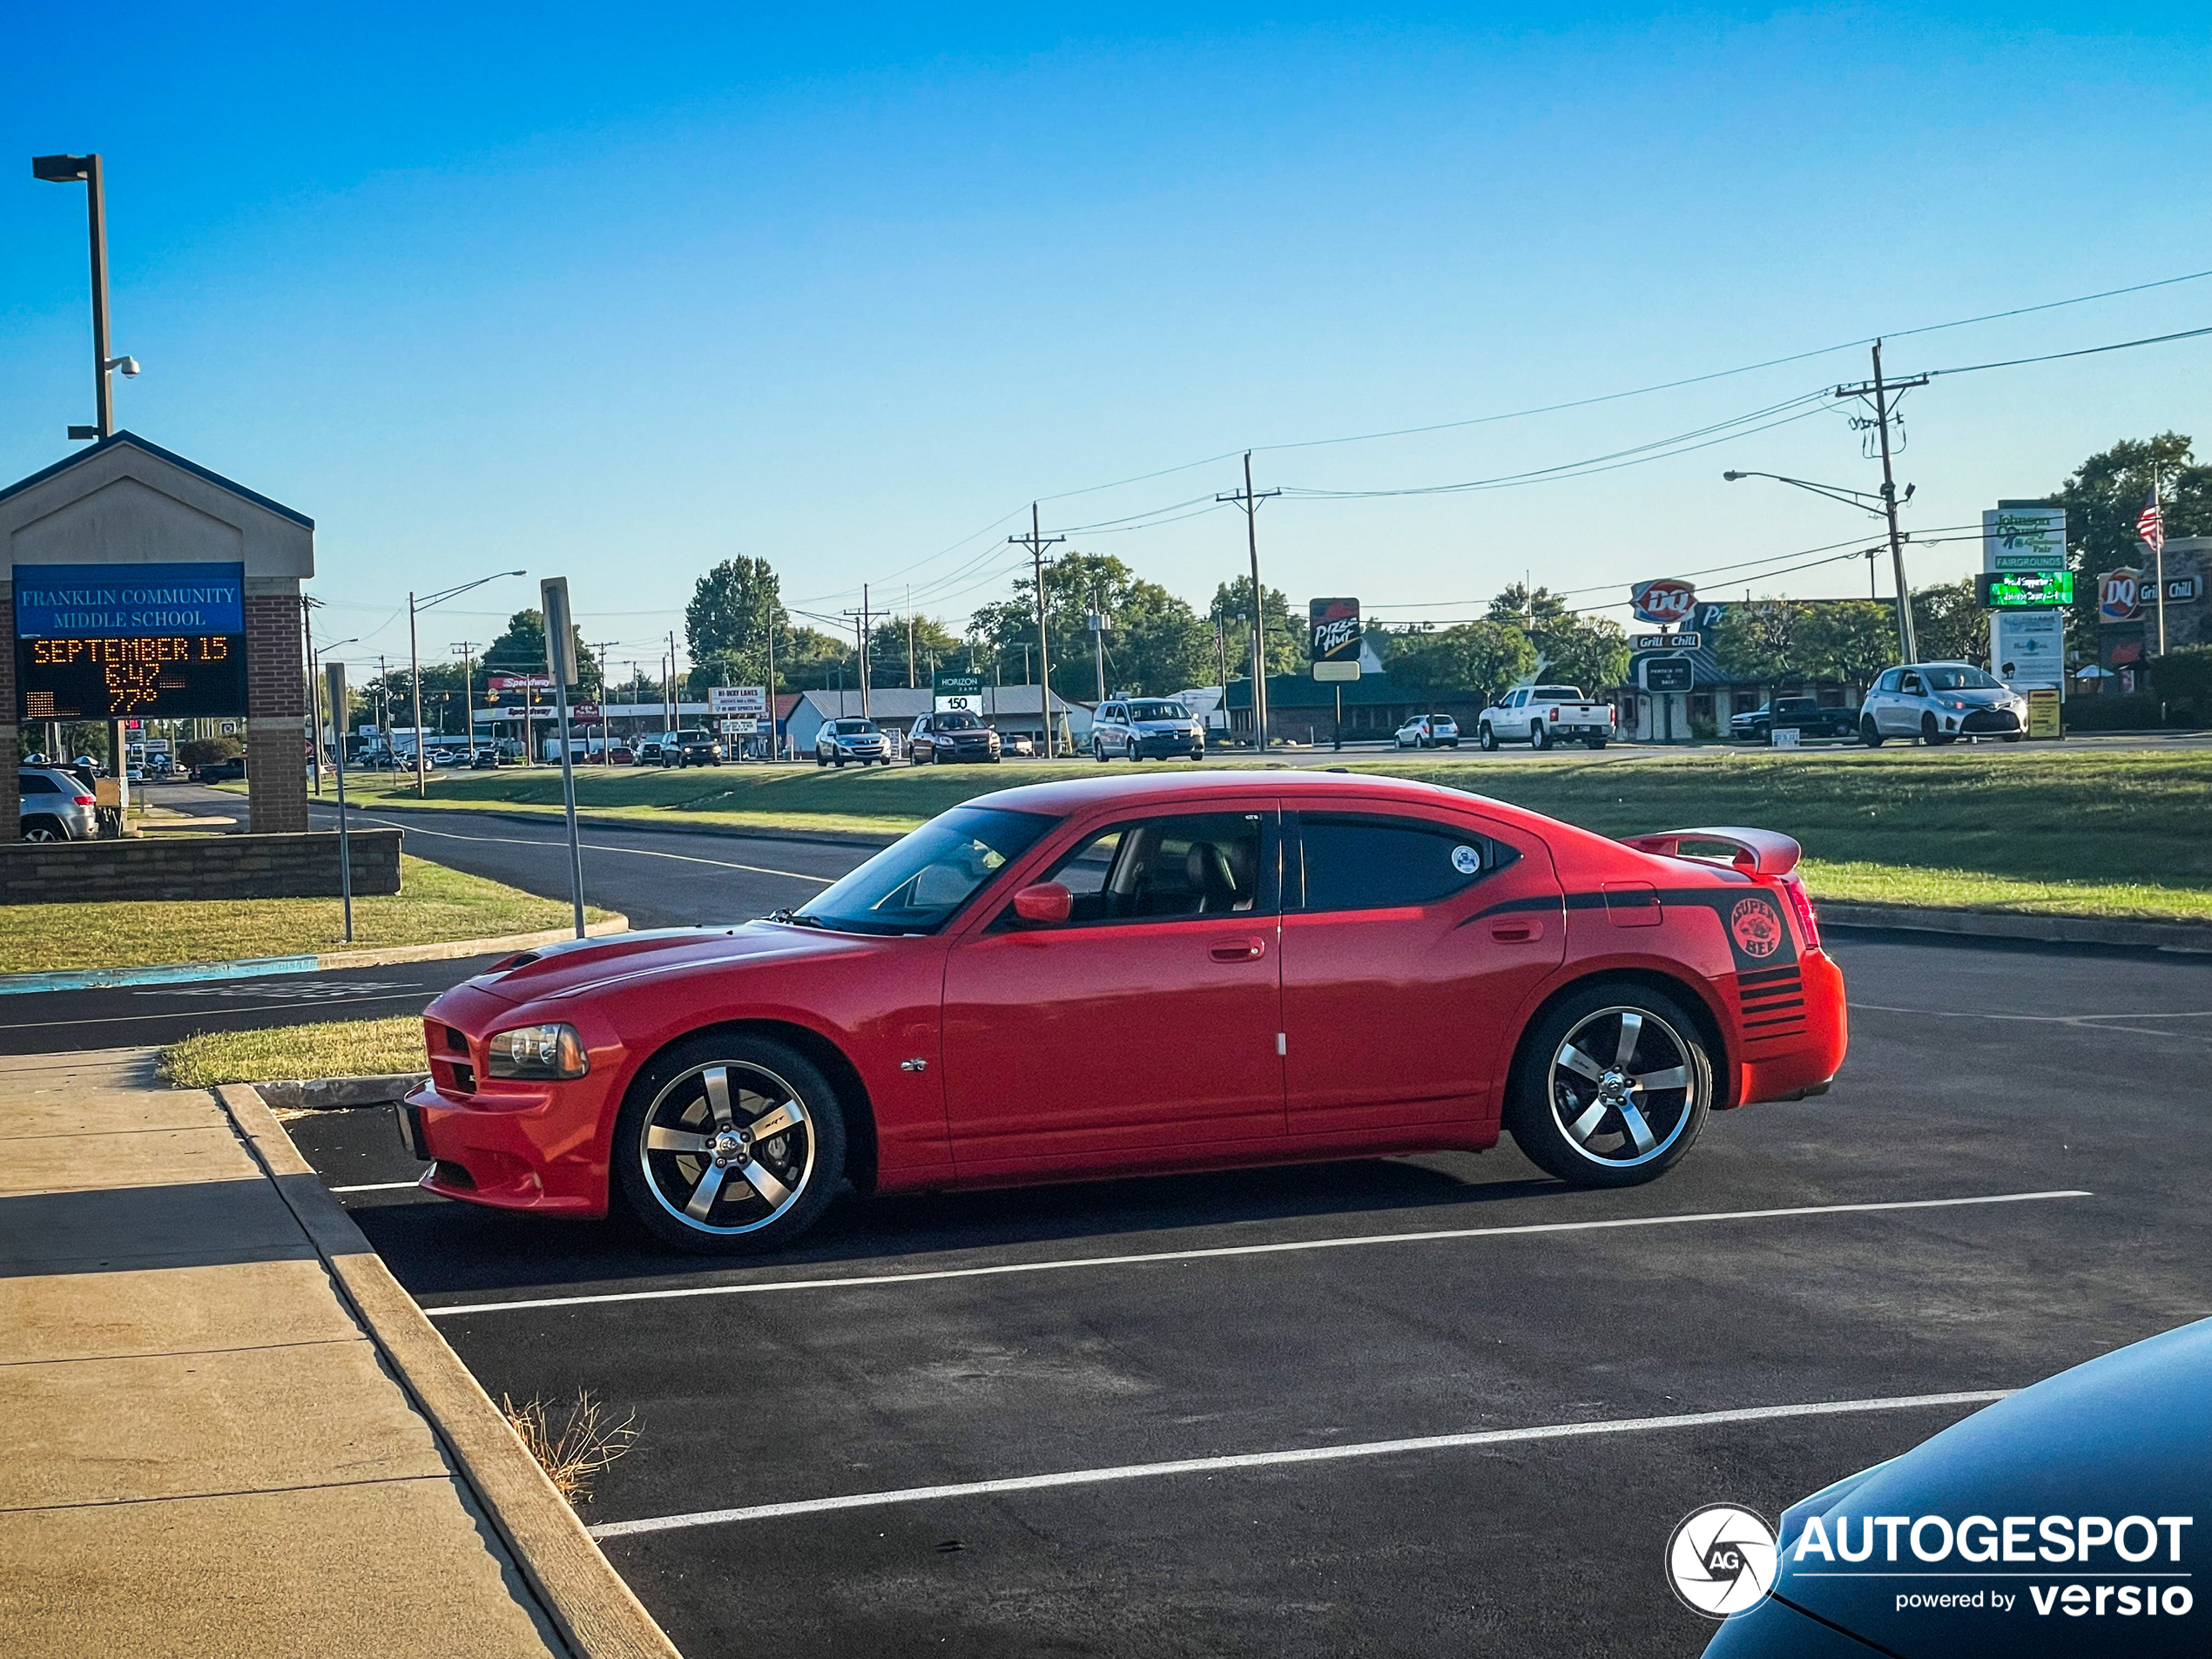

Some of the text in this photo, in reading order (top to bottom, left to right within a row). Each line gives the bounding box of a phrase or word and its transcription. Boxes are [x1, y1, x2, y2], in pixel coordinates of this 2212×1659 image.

[1995, 514, 2051, 526] Johnson
[1997, 557, 2062, 567] FAIRGROUNDS
[23, 587, 236, 607] FRANKLIN COMMUNITY
[2107, 578, 2135, 608] DQ
[2141, 582, 2192, 599] Gril Chill
[1648, 589, 1689, 613] DQ
[54, 610, 206, 629] MIDDLE SCHOOL
[34, 636, 228, 664] SEPTEMBER 15
[1640, 635, 1696, 647] Grill Chill
[105, 664, 160, 686] 6:47
[941, 678, 977, 686] HORIZON
[109, 688, 158, 712] 77°
[508, 707, 550, 717] Spedway
[1733, 900, 1775, 927] SUPER
[1745, 938, 1775, 956] BEE
